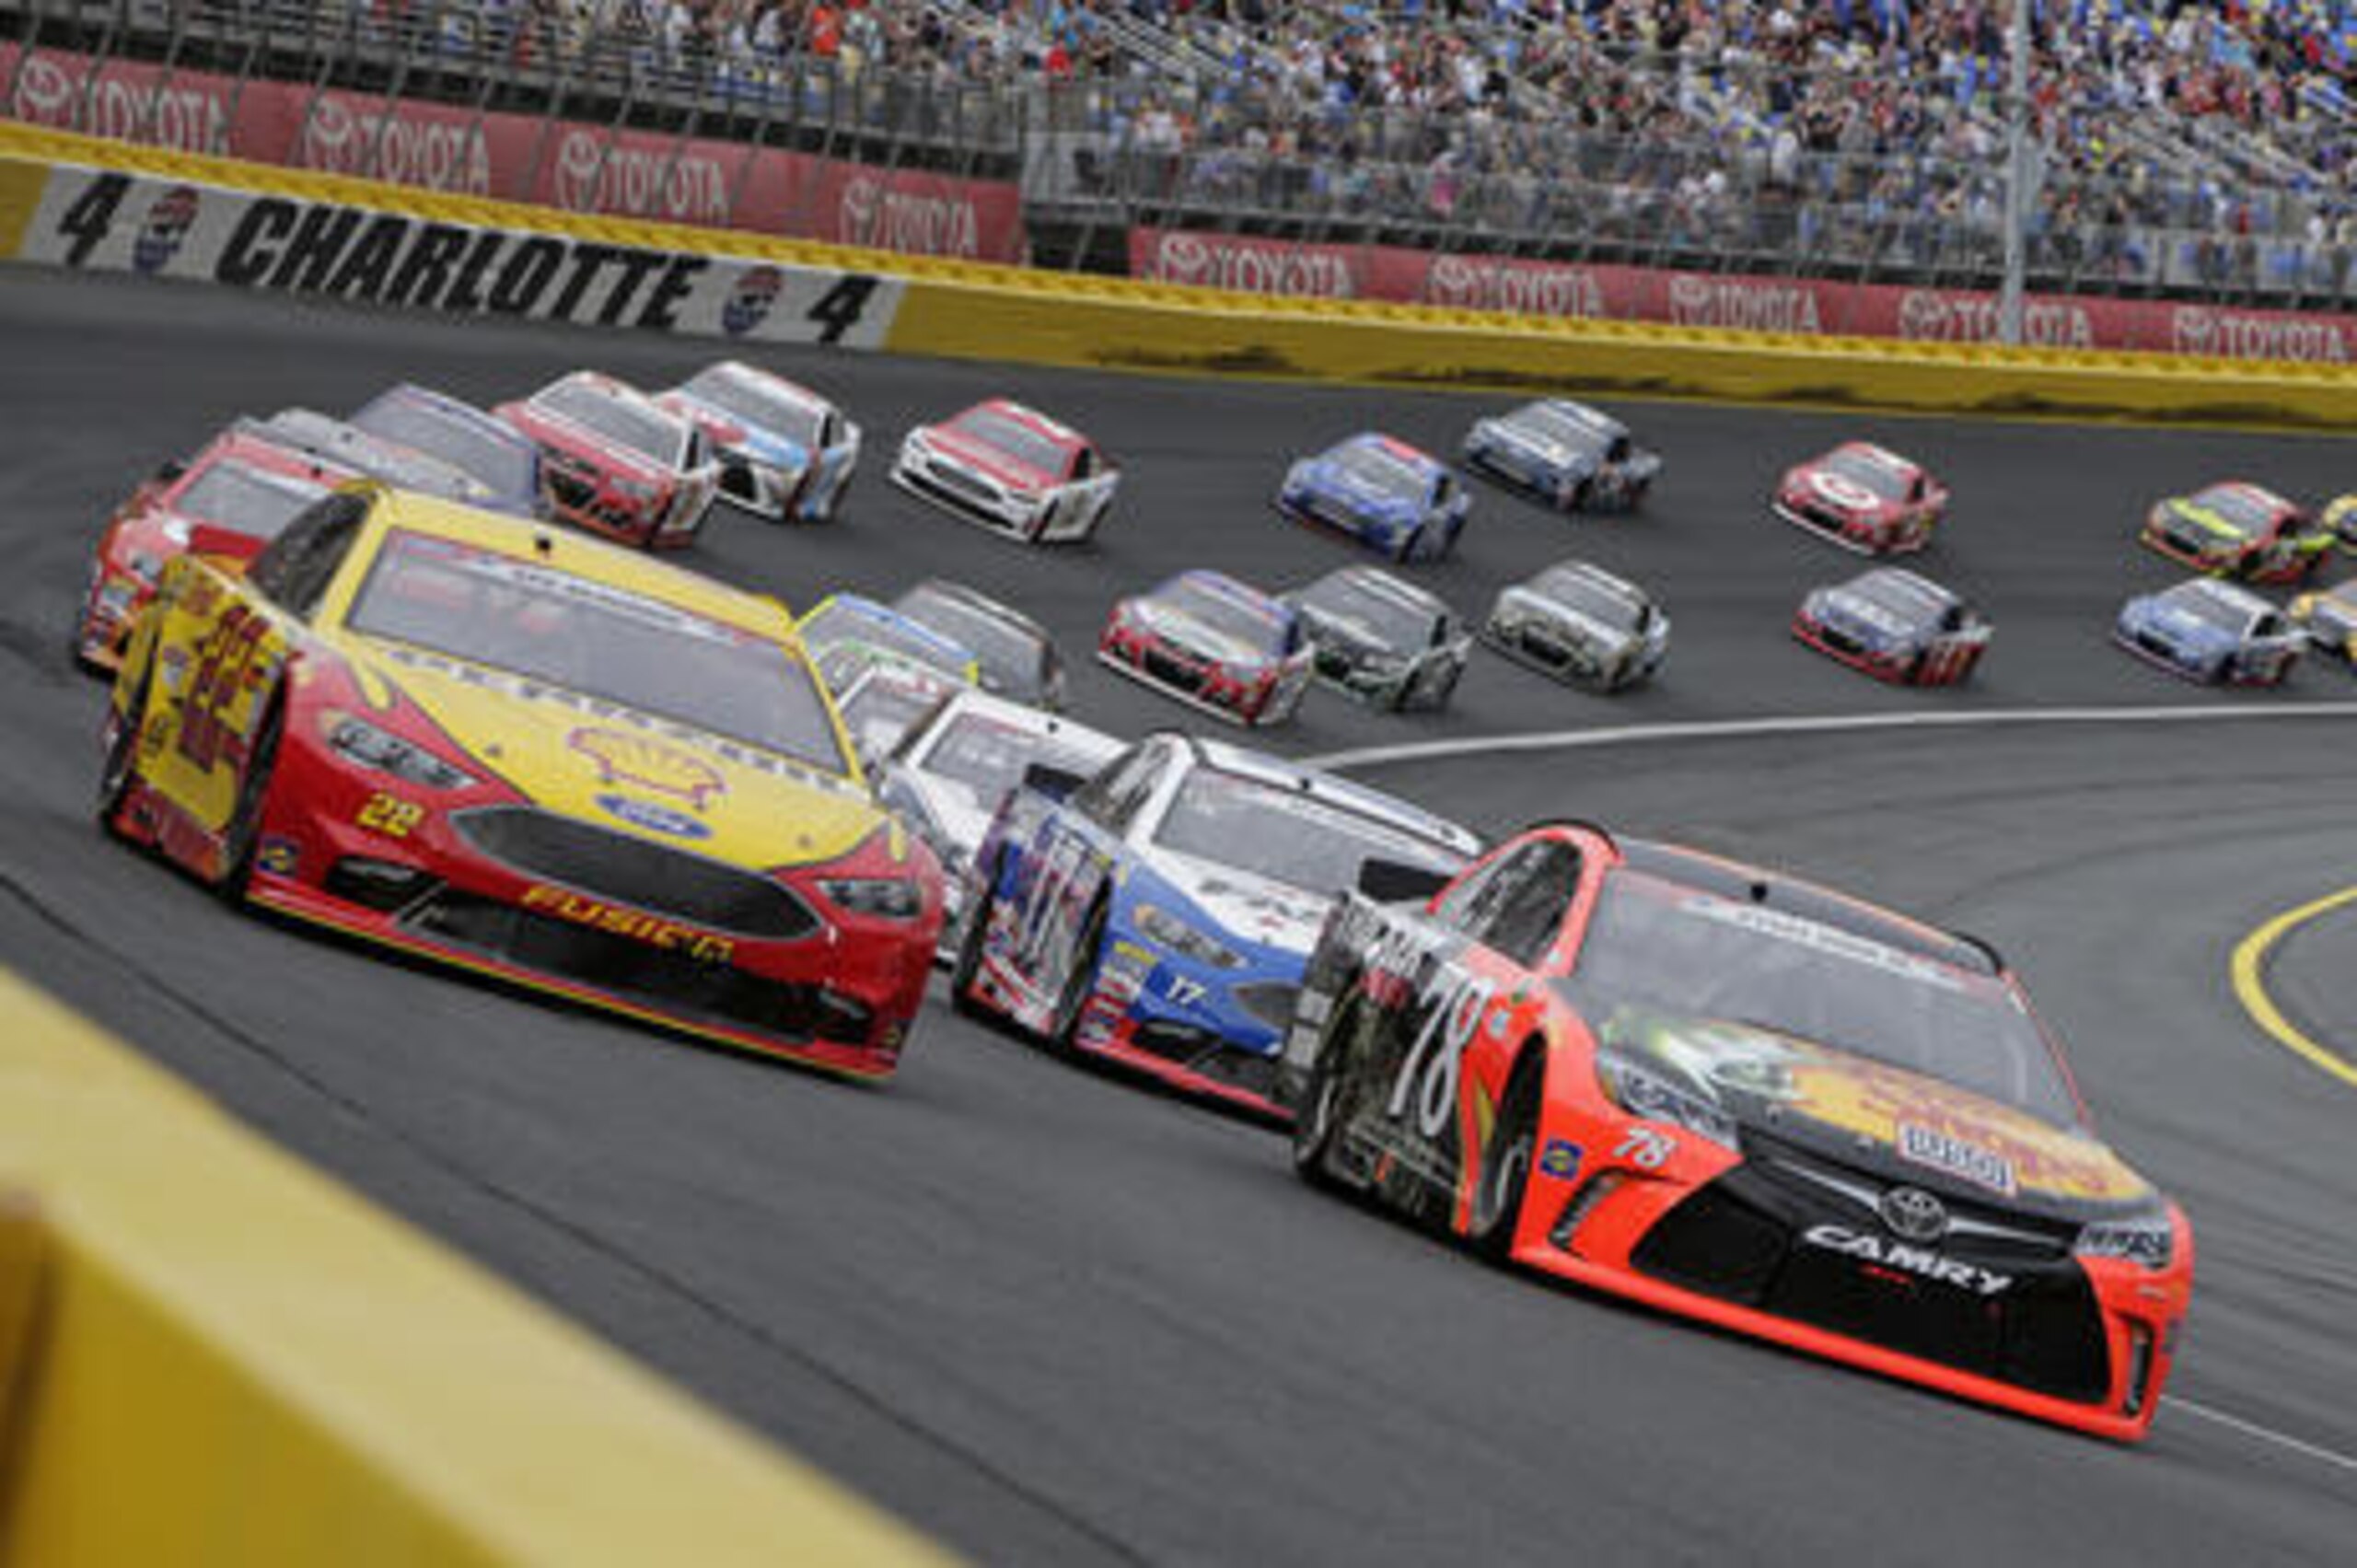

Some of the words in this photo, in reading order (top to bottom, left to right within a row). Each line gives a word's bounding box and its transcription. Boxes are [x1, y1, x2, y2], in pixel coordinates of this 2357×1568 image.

[79, 77, 228, 156] TOYOTA
[355, 115, 489, 193] TOYOTA
[606, 153, 729, 221] TOYOTA
[884, 194, 978, 258] TOYOTA
[59, 172, 130, 267] 4
[215, 198, 709, 328] CHARLOTTE
[807, 275, 879, 344] 4
[1210, 246, 1355, 296] TOYOTA
[1479, 265, 1604, 316] TOYOTA
[1714, 284, 1819, 332] TOYOTA
[2219, 318, 2346, 363] TOYOTA
[357, 790, 424, 837] 22
[1165, 975, 1207, 1005] 17
[1387, 960, 1493, 1137] 78
[1613, 1126, 1678, 1167] 78
[1804, 1225, 2013, 1295] CAMRY
